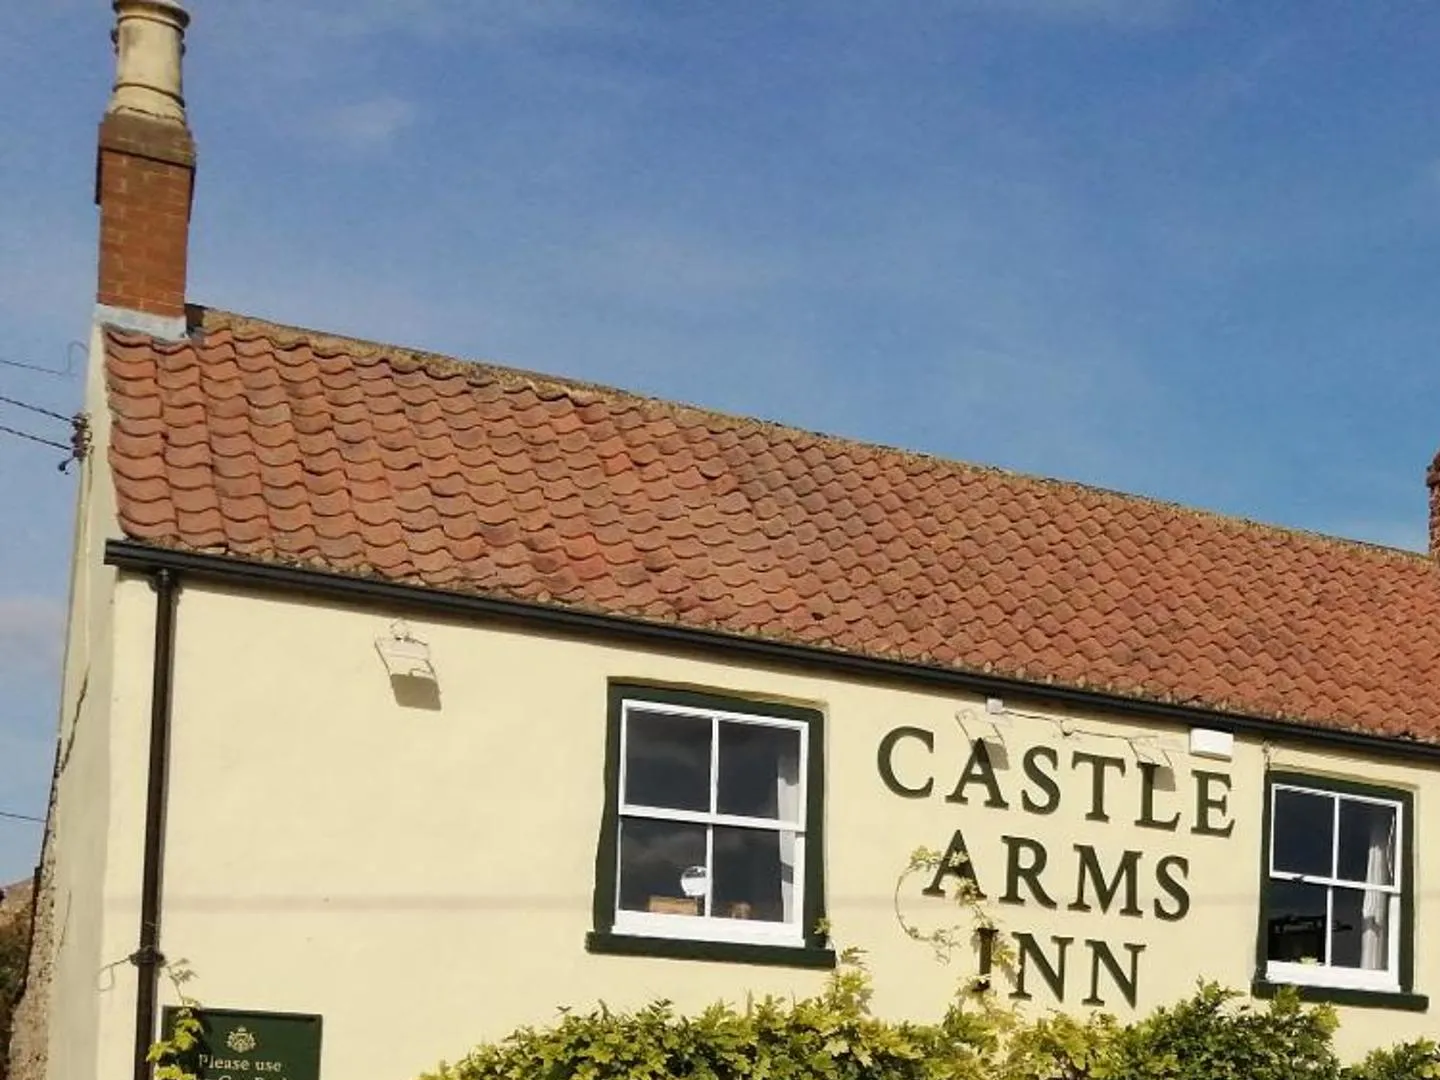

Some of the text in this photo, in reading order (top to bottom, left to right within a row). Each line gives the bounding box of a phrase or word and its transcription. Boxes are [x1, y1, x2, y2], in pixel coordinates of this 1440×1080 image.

[877, 725, 1235, 839] CASTLE
[922, 829, 1190, 922] ARMS
[971, 927, 1146, 1009] INN
[199, 1053, 282, 1072] Please use
